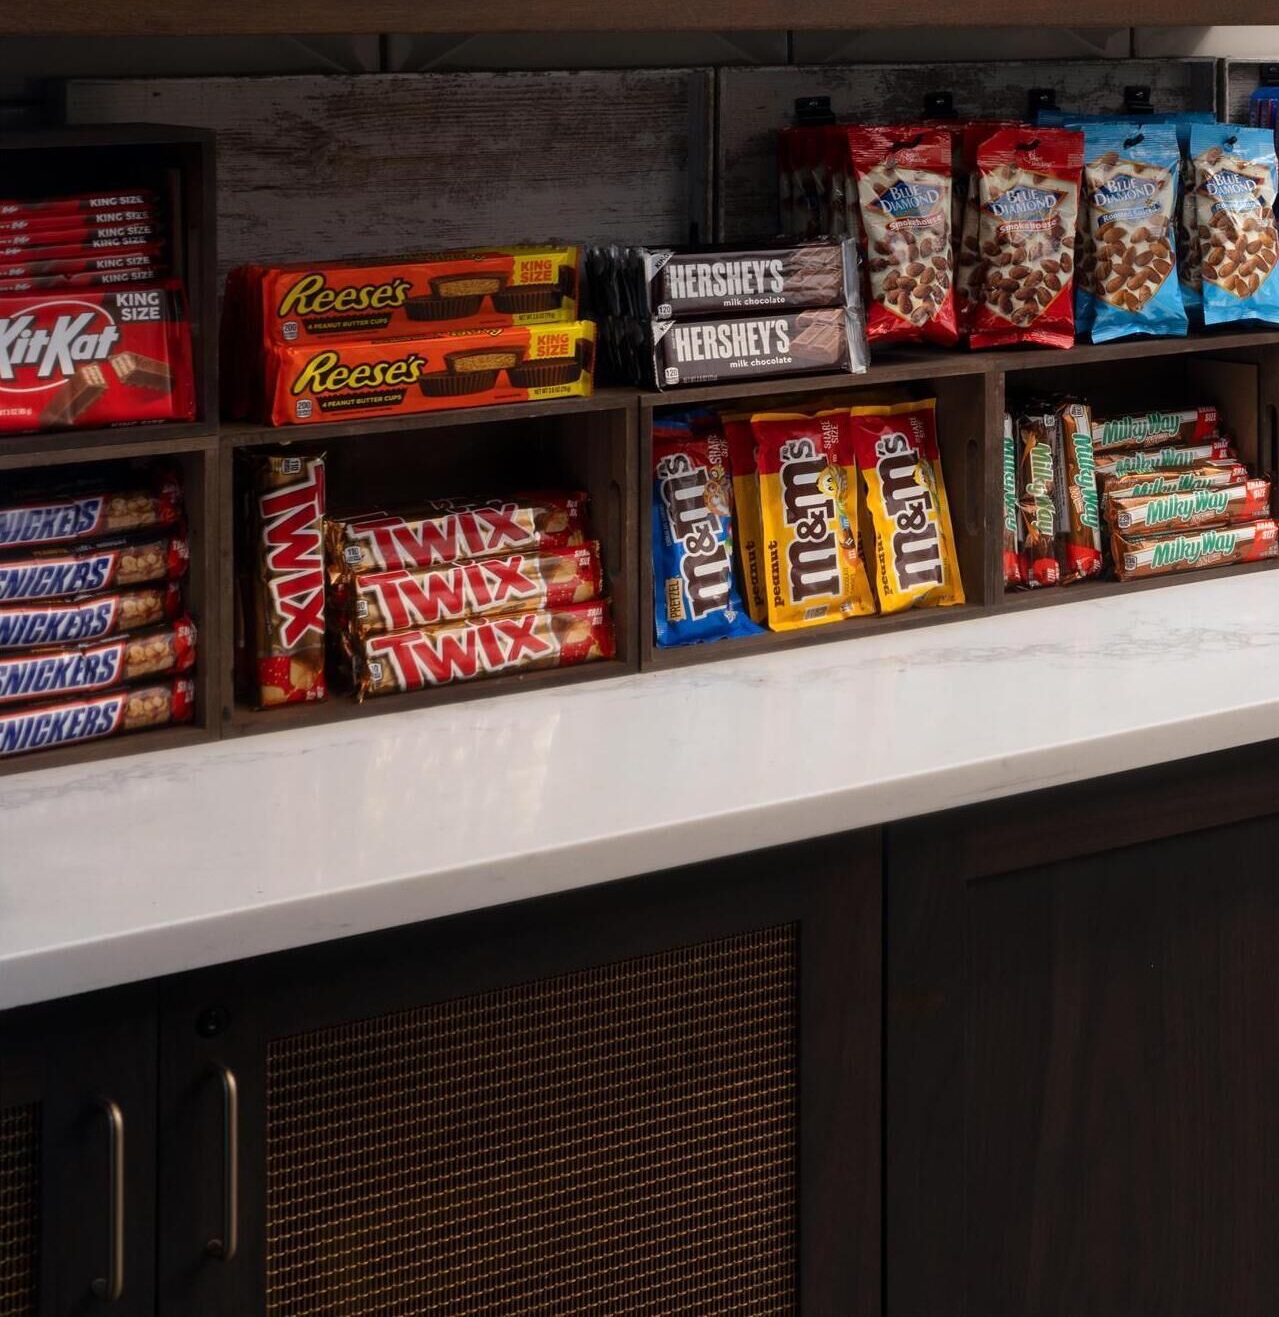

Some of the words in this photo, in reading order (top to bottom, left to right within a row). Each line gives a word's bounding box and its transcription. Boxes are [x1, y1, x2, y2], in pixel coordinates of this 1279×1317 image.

[889, 185, 920, 200] BLUE
[1007, 188, 1038, 204] BLUE
[1094, 182, 1155, 207] DIAMOND
[1108, 179, 1136, 194] BLUE
[1206, 178, 1257, 196] DIAMOND
[1215, 173, 1239, 187] BLUE
[880, 189, 940, 214] DIAMOND
[992, 194, 1057, 216] DIAMOND
[999, 217, 1057, 232] Smokehouse
[520, 260, 553, 272] KING
[520, 271, 553, 283] SIZE
[670, 259, 785, 299] HERSHEY'S
[116, 292, 160, 307] KING
[279, 274, 411, 316] Reese's
[723, 297, 741, 307] milk
[743, 296, 786, 306] chocolate
[121, 307, 161, 321] SIZE
[537, 333, 569, 345] KING
[537, 344, 569, 357] SIZE
[675, 319, 790, 363] HERSHEY'S
[293, 351, 426, 394] Reese's
[729, 359, 748, 369] milk
[750, 356, 792, 367] chocolate
[328, 399, 355, 407] PEANUT
[356, 397, 383, 405] BUTTER
[1102, 416, 1148, 447] Milky
[1148, 411, 1182, 435] Way
[1072, 433, 1096, 488] Milky
[1080, 487, 1099, 529] Way
[1146, 494, 1196, 526] Milky
[1195, 489, 1230, 513] Way
[259, 460, 325, 648] TWIX
[352, 502, 533, 570] TWIX
[1152, 537, 1203, 569] Milky
[1202, 531, 1237, 555] Way
[746, 540, 763, 607] peanut
[768, 540, 784, 608] peanut
[358, 554, 538, 631] TWIX
[668, 579, 680, 621] PRETZEL
[0, 602, 112, 645] NICKERS
[370, 613, 553, 691] TWIX
[0, 648, 119, 695] NICKERS
[0, 700, 119, 753] NICKERS
